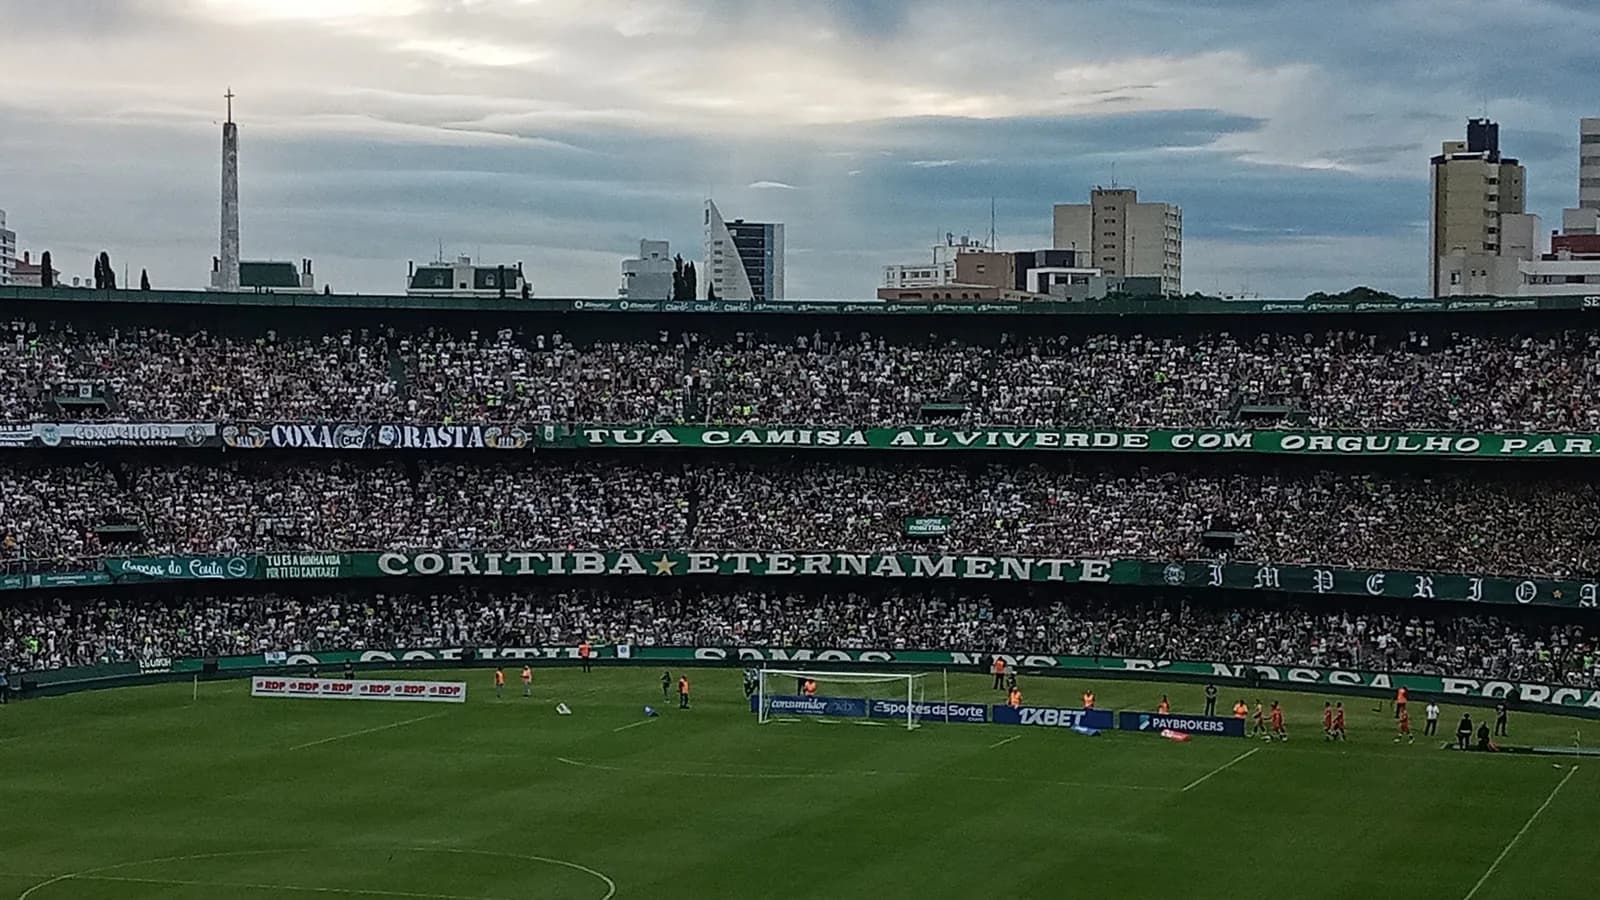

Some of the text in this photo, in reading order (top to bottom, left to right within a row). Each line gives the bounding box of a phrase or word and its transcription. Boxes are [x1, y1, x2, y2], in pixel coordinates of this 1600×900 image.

[271, 425, 332, 448] COXA
[402, 425, 484, 448] RASTA
[584, 429, 1600, 453] TUA CAMISA ALVIVERDE COM ORGULHO PAR
[168, 560, 181, 575] do
[377, 552, 1112, 582] CORITIBA ETERNAMENTE
[265, 681, 286, 690] RDP
[299, 682, 319, 691] RDP
[332, 683, 353, 692] RDP
[370, 684, 391, 693] RDP
[404, 685, 426, 694] RDP
[439, 686, 460, 695] RDP
[949, 705, 984, 717] Sorte
[1019, 708, 1086, 727] 1XBET
[1153, 718, 1225, 732] PAYBROKERS
